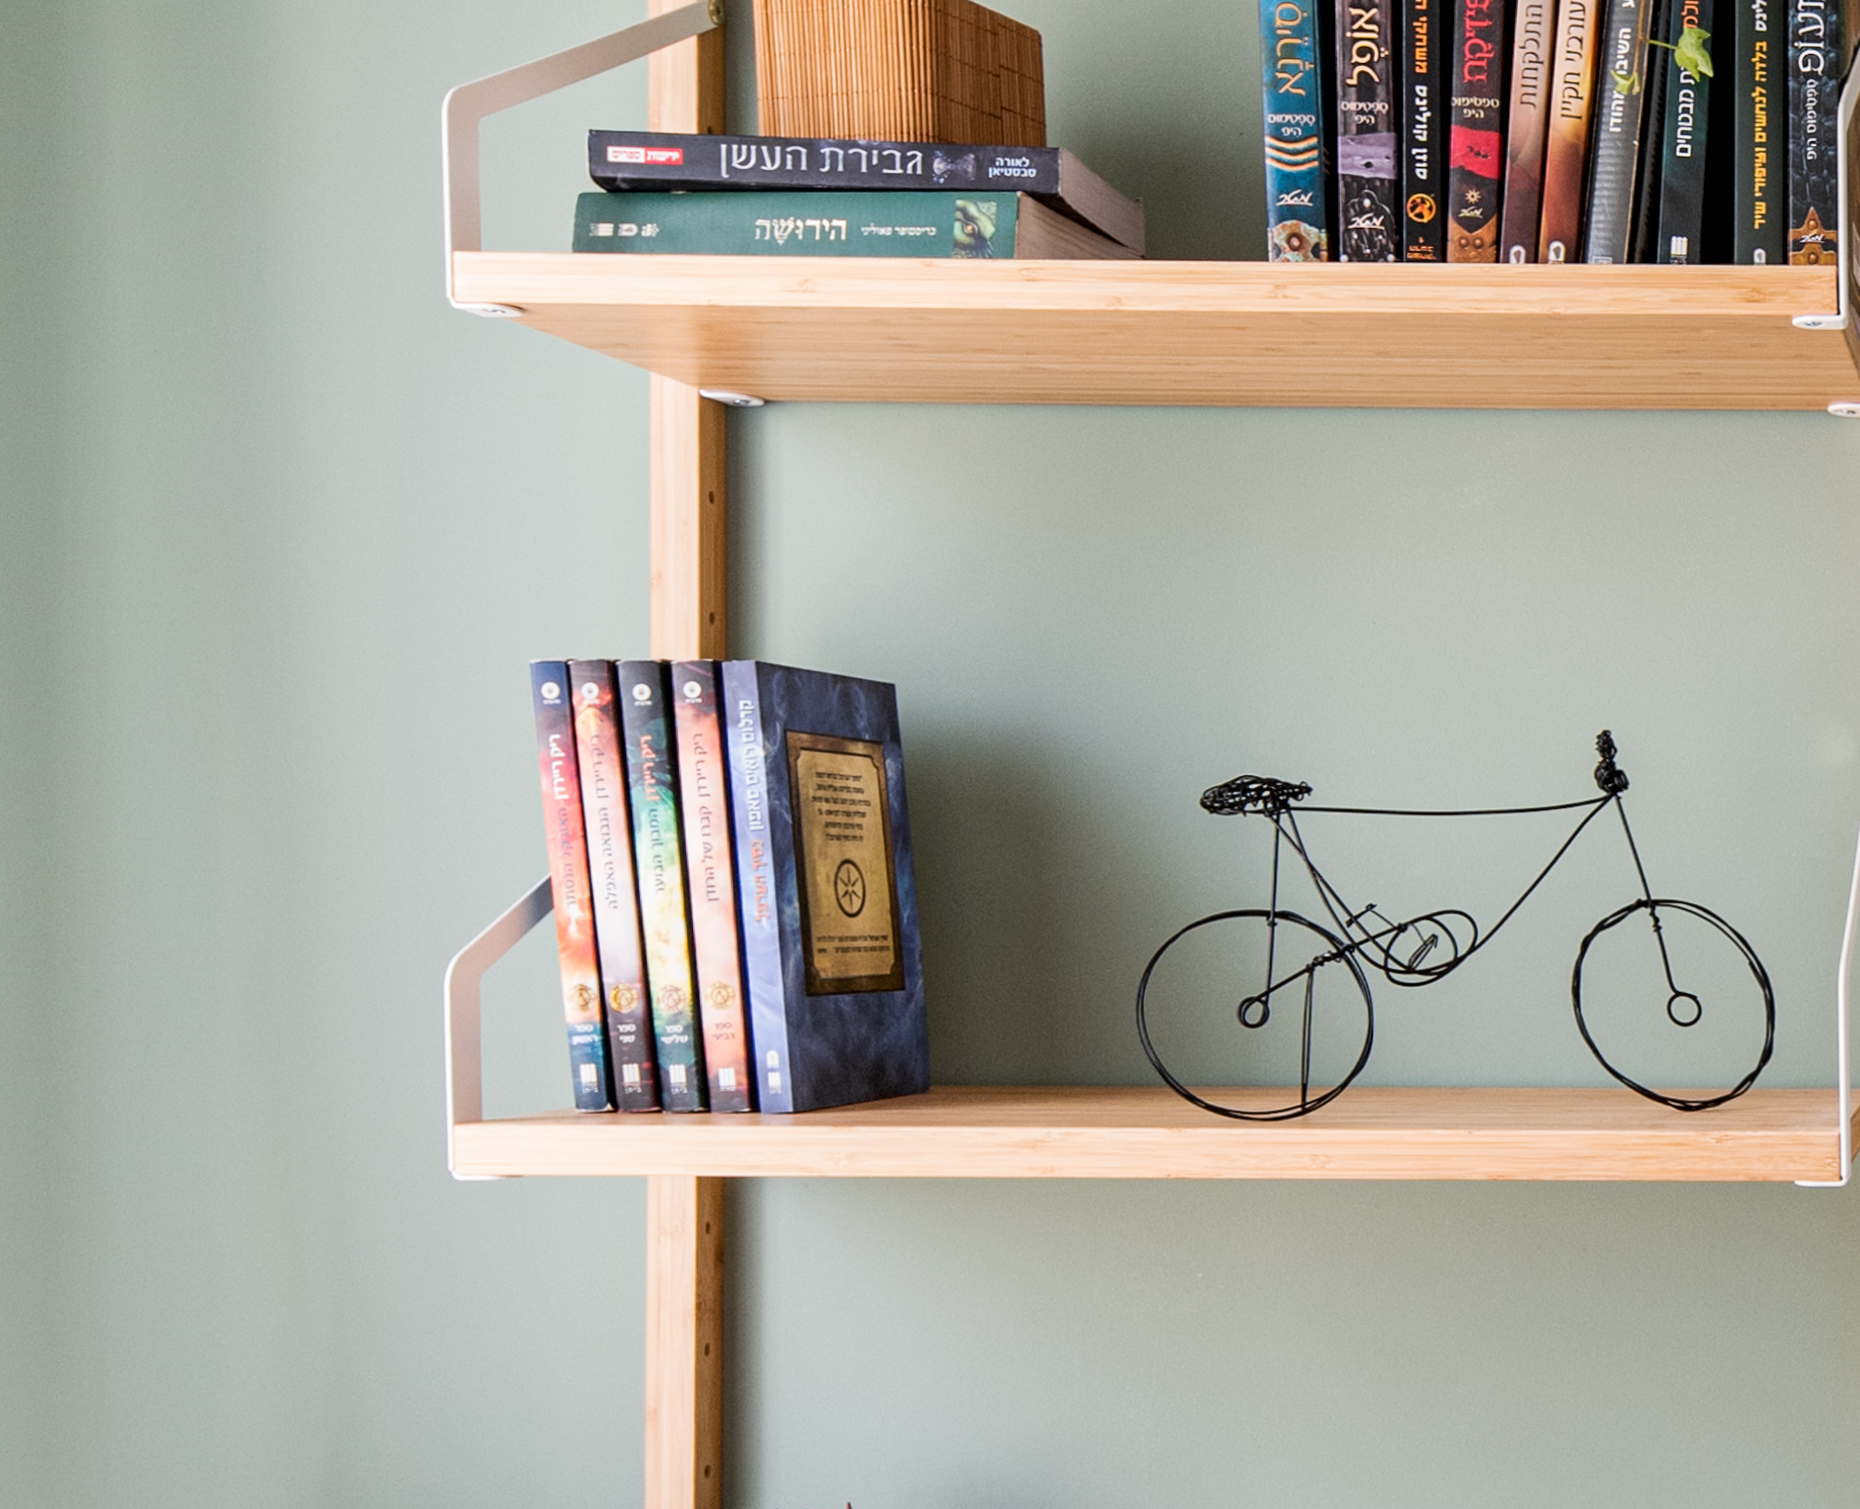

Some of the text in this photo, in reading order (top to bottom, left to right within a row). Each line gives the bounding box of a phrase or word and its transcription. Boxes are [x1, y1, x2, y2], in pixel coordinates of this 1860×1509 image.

[1412, 16, 1428, 74] משחקי
[1518, 3, 1544, 109] התלקחות
[1560, 0, 1586, 121] עורבני חקיין
[1750, 41, 1767, 82] בלדה
[1411, 85, 1432, 181] סוזן קולינס
[1675, 89, 1695, 158] מבטחים
[1750, 86, 1767, 143] לנחשים
[720, 143, 923, 178] גבירת העשן
[988, 166, 1037, 178] סבסטיאן
[995, 155, 1030, 167] לאורה
[1754, 201, 1767, 230] שיר
[548, 734, 569, 800] ריק ריירדן
[590, 733, 608, 799] ריק ריירדן
[640, 734, 659, 802] ריק ריירדן
[691, 732, 711, 799] ריק ריירדן
[739, 700, 764, 831] קרלוס רואיס סאפון
[599, 806, 619, 910] הנבואה האפלה
[647, 807, 667, 894] המבוך הבוער
[699, 805, 720, 902] קברו של הרודן
[616, 1023, 637, 1033] ספר
[619, 1035, 636, 1044] שני
[660, 1035, 689, 1045] שלישי
[665, 1024, 684, 1034] ספר
[713, 1021, 732, 1030] ספר
